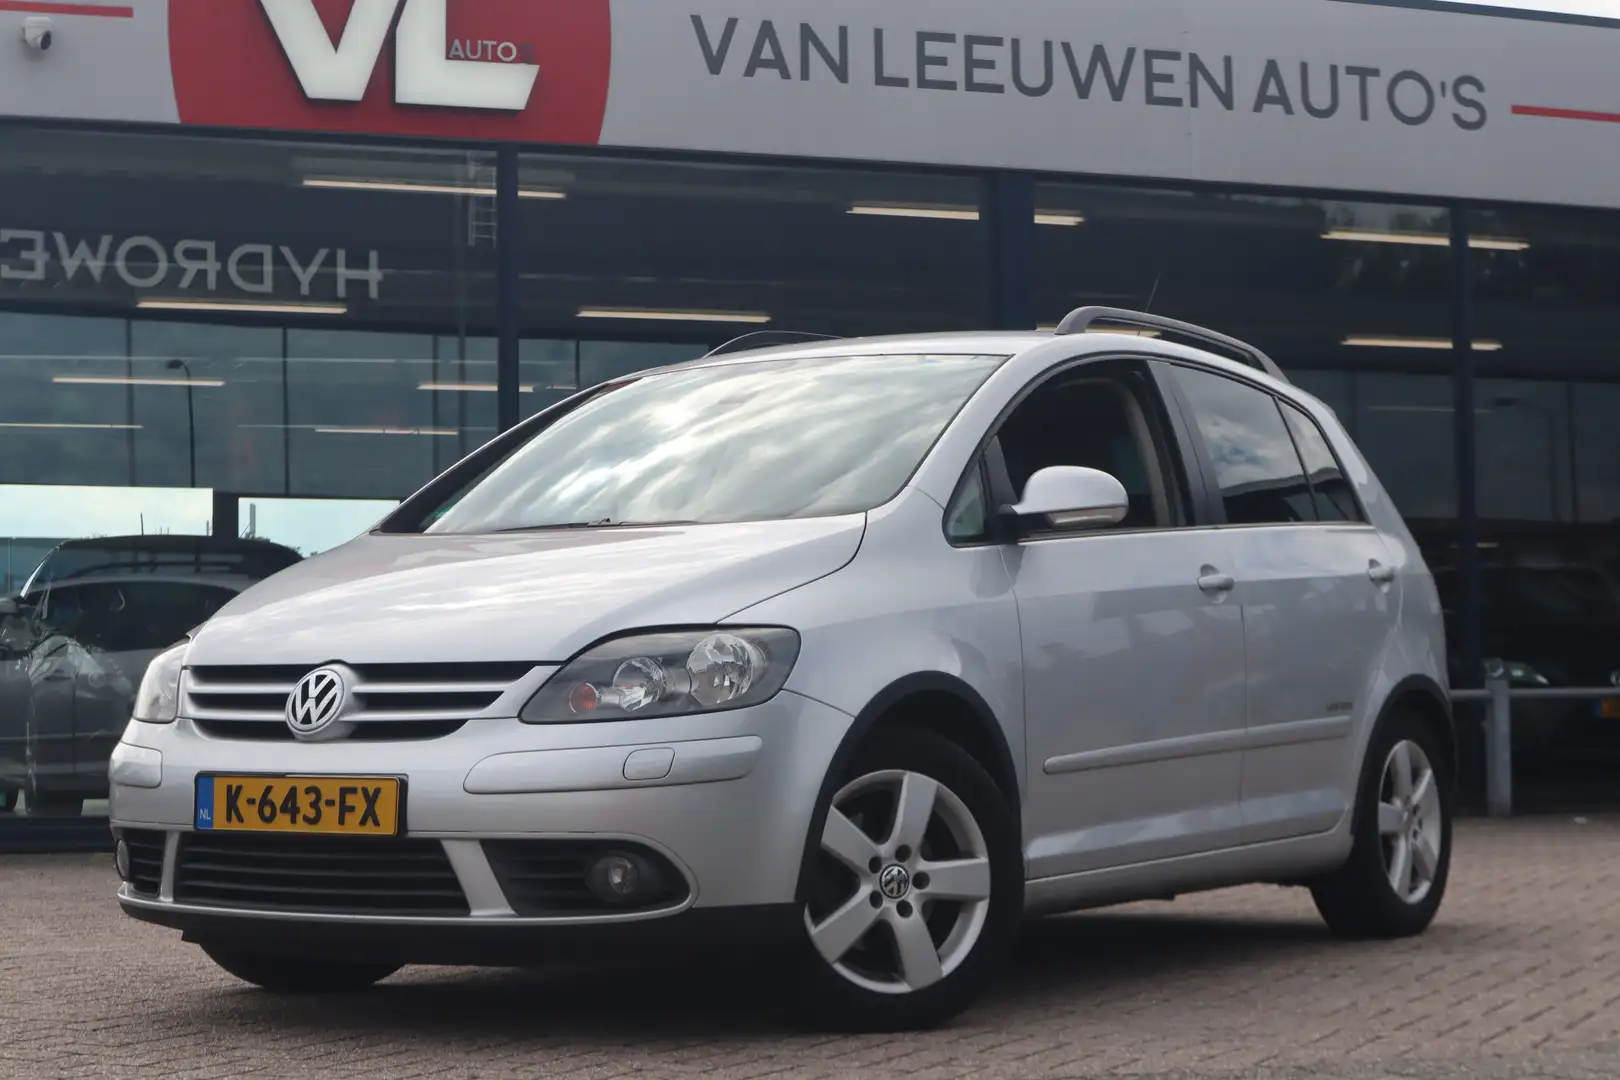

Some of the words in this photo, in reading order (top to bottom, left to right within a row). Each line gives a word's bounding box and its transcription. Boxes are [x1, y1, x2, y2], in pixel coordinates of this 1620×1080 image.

[690, 14, 849, 84] VAN
[874, 28, 1234, 111] LEEUWEN
[1252, 59, 1487, 131] AUTO'S
[199, 808, 212, 821] NL
[225, 783, 382, 828] K-643-FX
